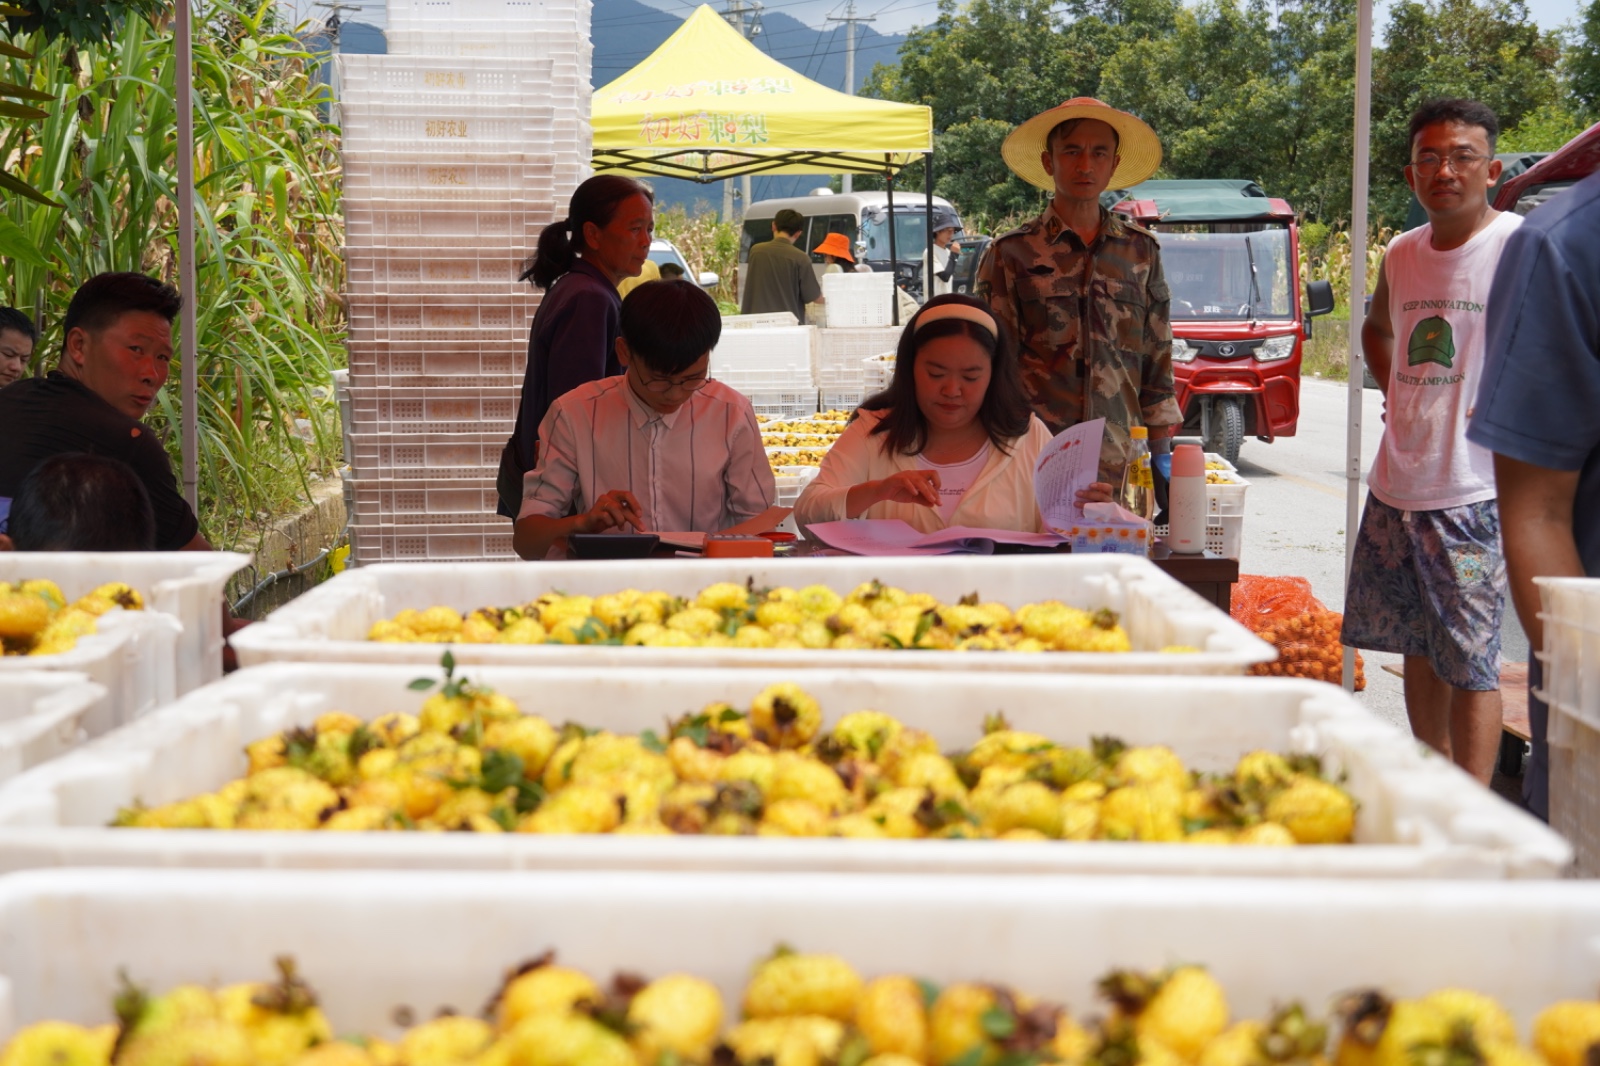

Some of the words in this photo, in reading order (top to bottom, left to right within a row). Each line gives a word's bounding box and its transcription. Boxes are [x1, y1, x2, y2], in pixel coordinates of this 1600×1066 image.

[425, 119, 468, 138] 初好农业
[1420, 300, 1485, 313] INNOVATION
